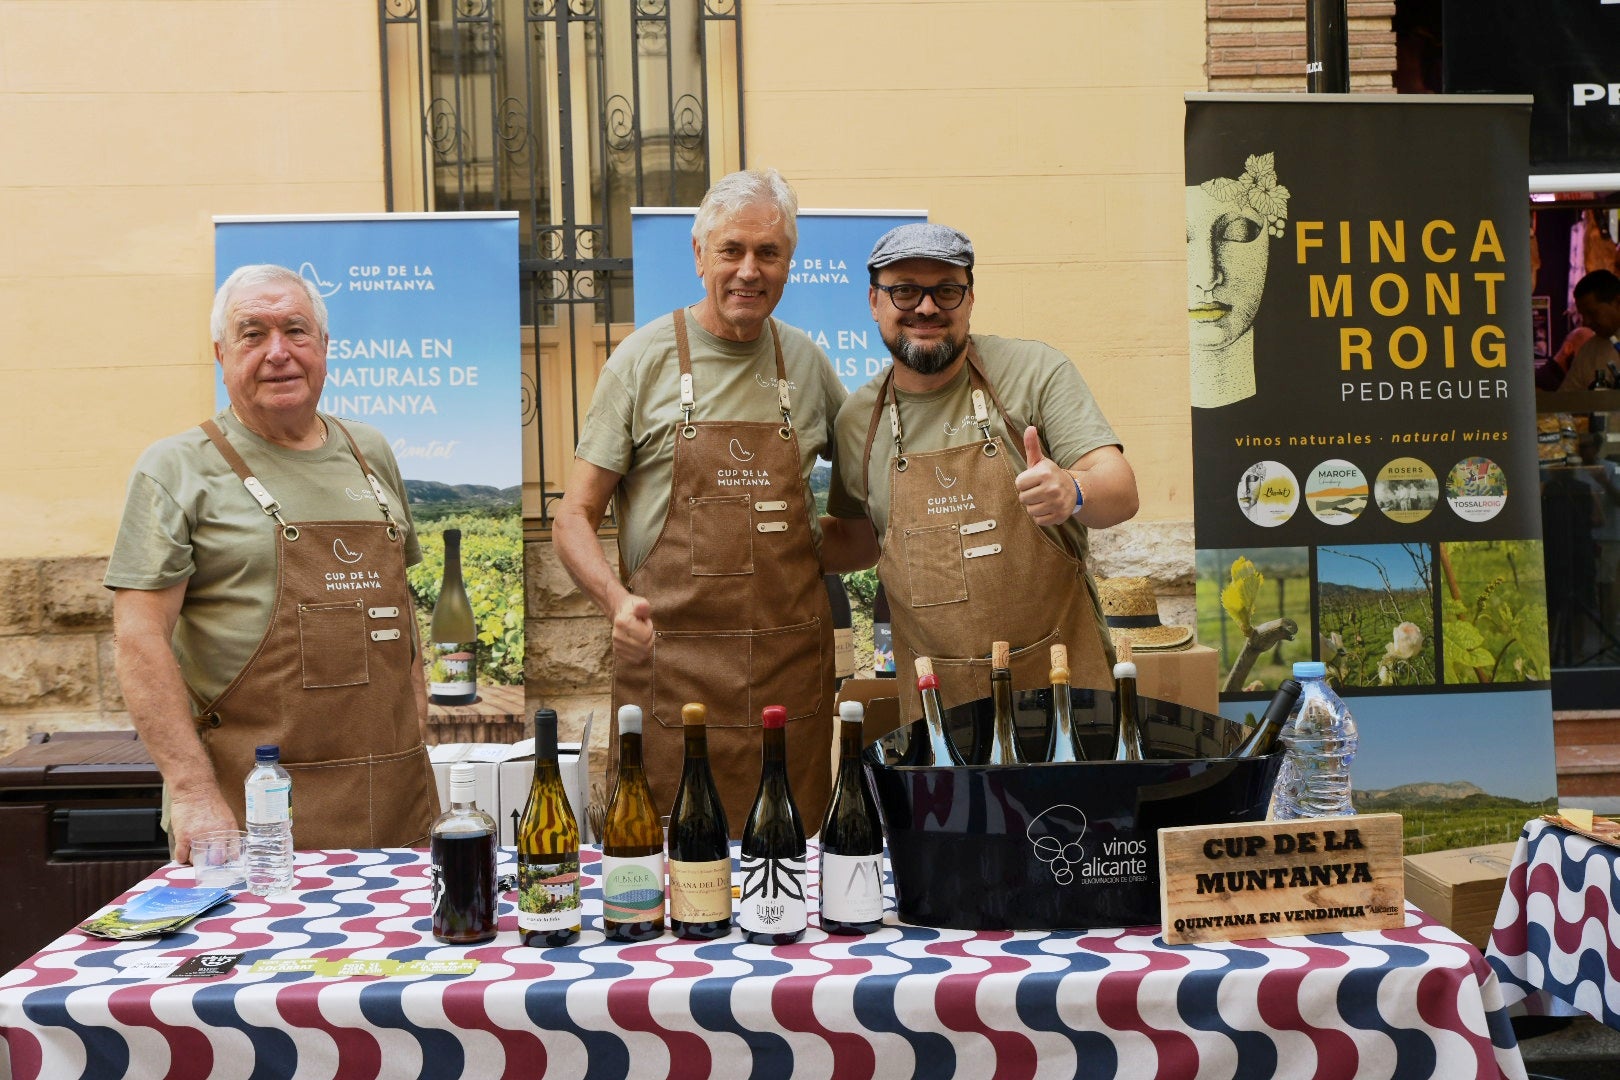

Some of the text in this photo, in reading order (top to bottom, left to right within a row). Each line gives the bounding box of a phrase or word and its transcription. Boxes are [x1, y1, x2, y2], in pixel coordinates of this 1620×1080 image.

[1296, 219, 1506, 264] FINCA
[349, 265, 433, 277] CUP DE LA
[804, 259, 822, 270] DE
[829, 259, 847, 270] LA
[349, 280, 435, 292] MUNTANYA
[790, 272, 850, 284] NTANYA
[1308, 272, 1506, 318] MONT
[327, 338, 453, 358] ESANIA EN
[837, 330, 868, 350] EN
[1339, 324, 1507, 371] ROIG
[326, 366, 479, 387] NATURALS DE
[1341, 379, 1508, 402] PEDREGUER
[320, 395, 437, 414] UNTANYA
[1235, 428, 1509, 447] vinos naturales natural wines
[717, 469, 769, 477] CUP DE LA
[1318, 469, 1357, 478] MAROFE
[1388, 466, 1424, 474] ROSERS
[717, 478, 771, 486] MUNTANYA
[927, 497, 947, 506] CUP
[961, 493, 974, 501] LA
[927, 503, 976, 515] MUNTANYA
[324, 570, 380, 581] CUP DE LA
[326, 581, 382, 591] MUNTANYA
[1103, 837, 1147, 856] vinos
[1203, 828, 1366, 860] CUP DE LA
[1081, 856, 1147, 877] alicante
[1196, 862, 1373, 895] MUNTANYA
[1174, 913, 1256, 932] QUINTANA
[1259, 911, 1281, 924] EN
[1284, 905, 1366, 923] VENDIMIA
